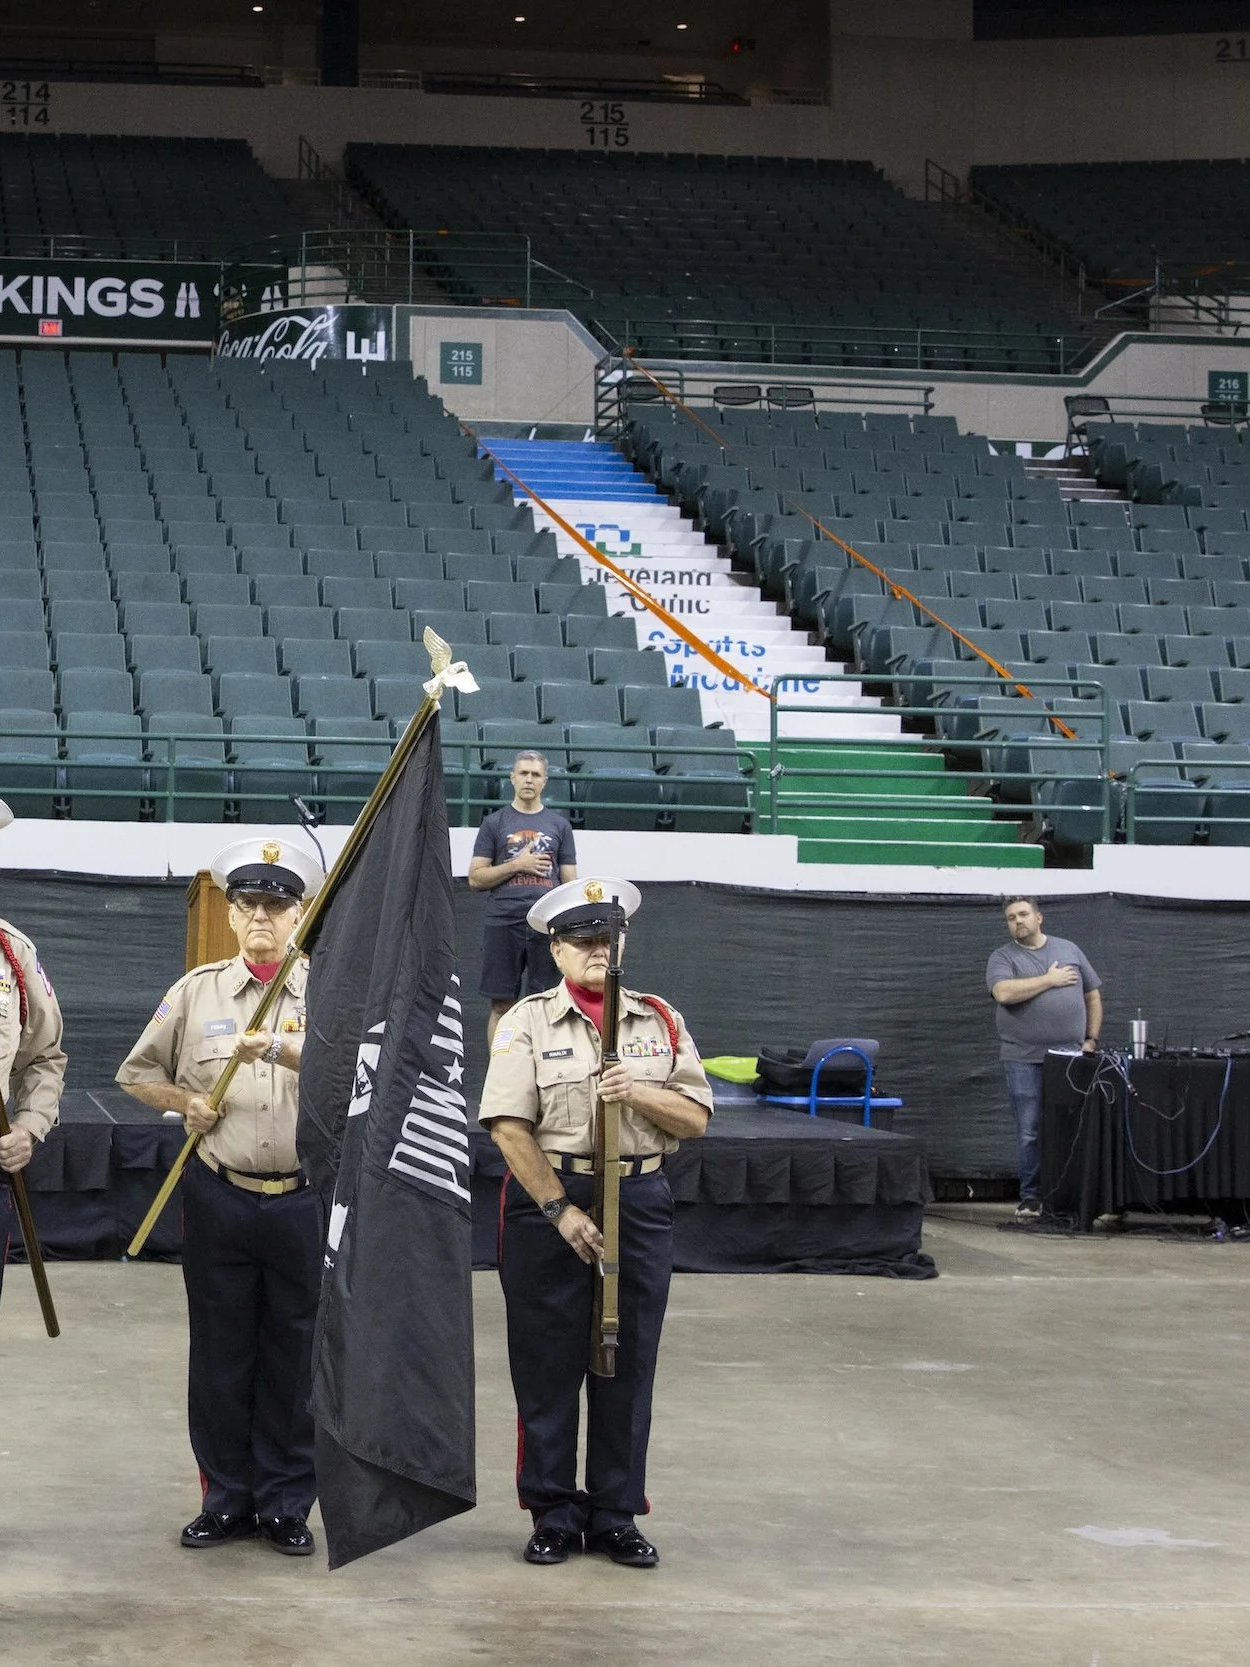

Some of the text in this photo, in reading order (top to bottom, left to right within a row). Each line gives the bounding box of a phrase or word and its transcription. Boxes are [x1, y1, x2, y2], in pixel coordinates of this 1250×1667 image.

[2, 81, 51, 102] 214
[6, 106, 50, 126] 114
[580, 101, 625, 122] 215
[585, 126, 629, 147] 115
[451, 350, 474, 361] 215
[452, 366, 473, 377] 115
[1219, 378, 1240, 390] 216
